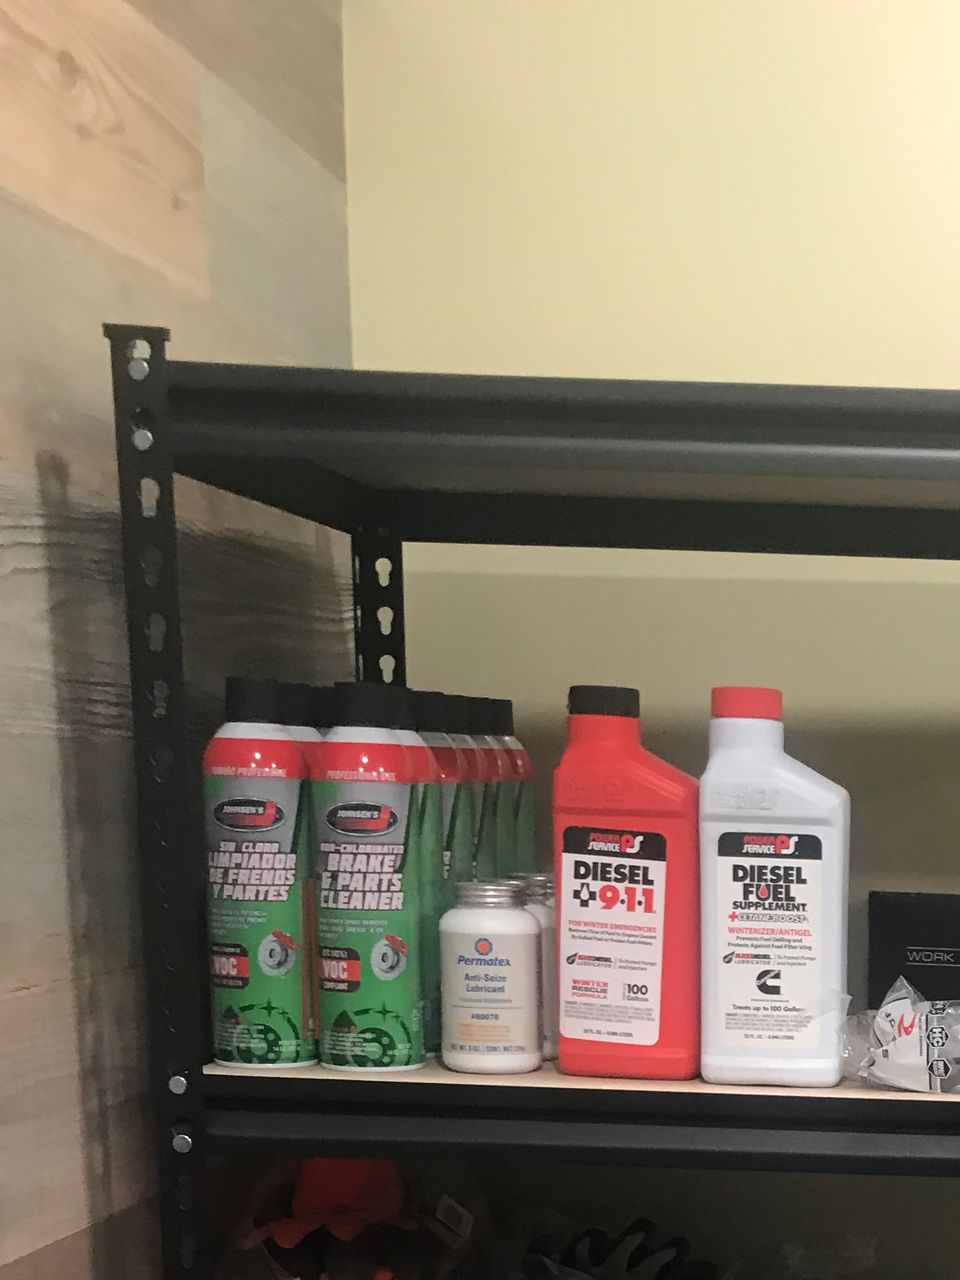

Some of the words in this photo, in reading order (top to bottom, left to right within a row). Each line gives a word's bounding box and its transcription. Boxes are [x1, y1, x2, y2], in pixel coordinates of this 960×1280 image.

[587, 841, 620, 852] SERVICE
[742, 844, 775, 854] SERVICE
[208, 852, 297, 869] LIMPIADOR
[327, 853, 396, 872] BRAKE
[209, 867, 225, 883] DE
[227, 869, 296, 885] FRENOS
[573, 860, 654, 886] DIESEL
[732, 864, 807, 885] DIESEL
[336, 873, 403, 892] PARTS
[212, 884, 221, 899] Y
[222, 884, 290, 901] PARTES
[319, 891, 404, 910] CLEANER
[742, 883, 796, 902] FUEL
[731, 901, 807, 912] SUPPLEMENT
[727, 926, 812, 937] WINTERIZER/ANTIGEL
[457, 955, 512, 967] Permatex
[907, 950, 954, 963] WORK
[323, 959, 349, 978] VOC
[464, 973, 507, 982] Anti-Seize
[465, 983, 506, 993] Lubricant
[627, 983, 648, 996] 100
